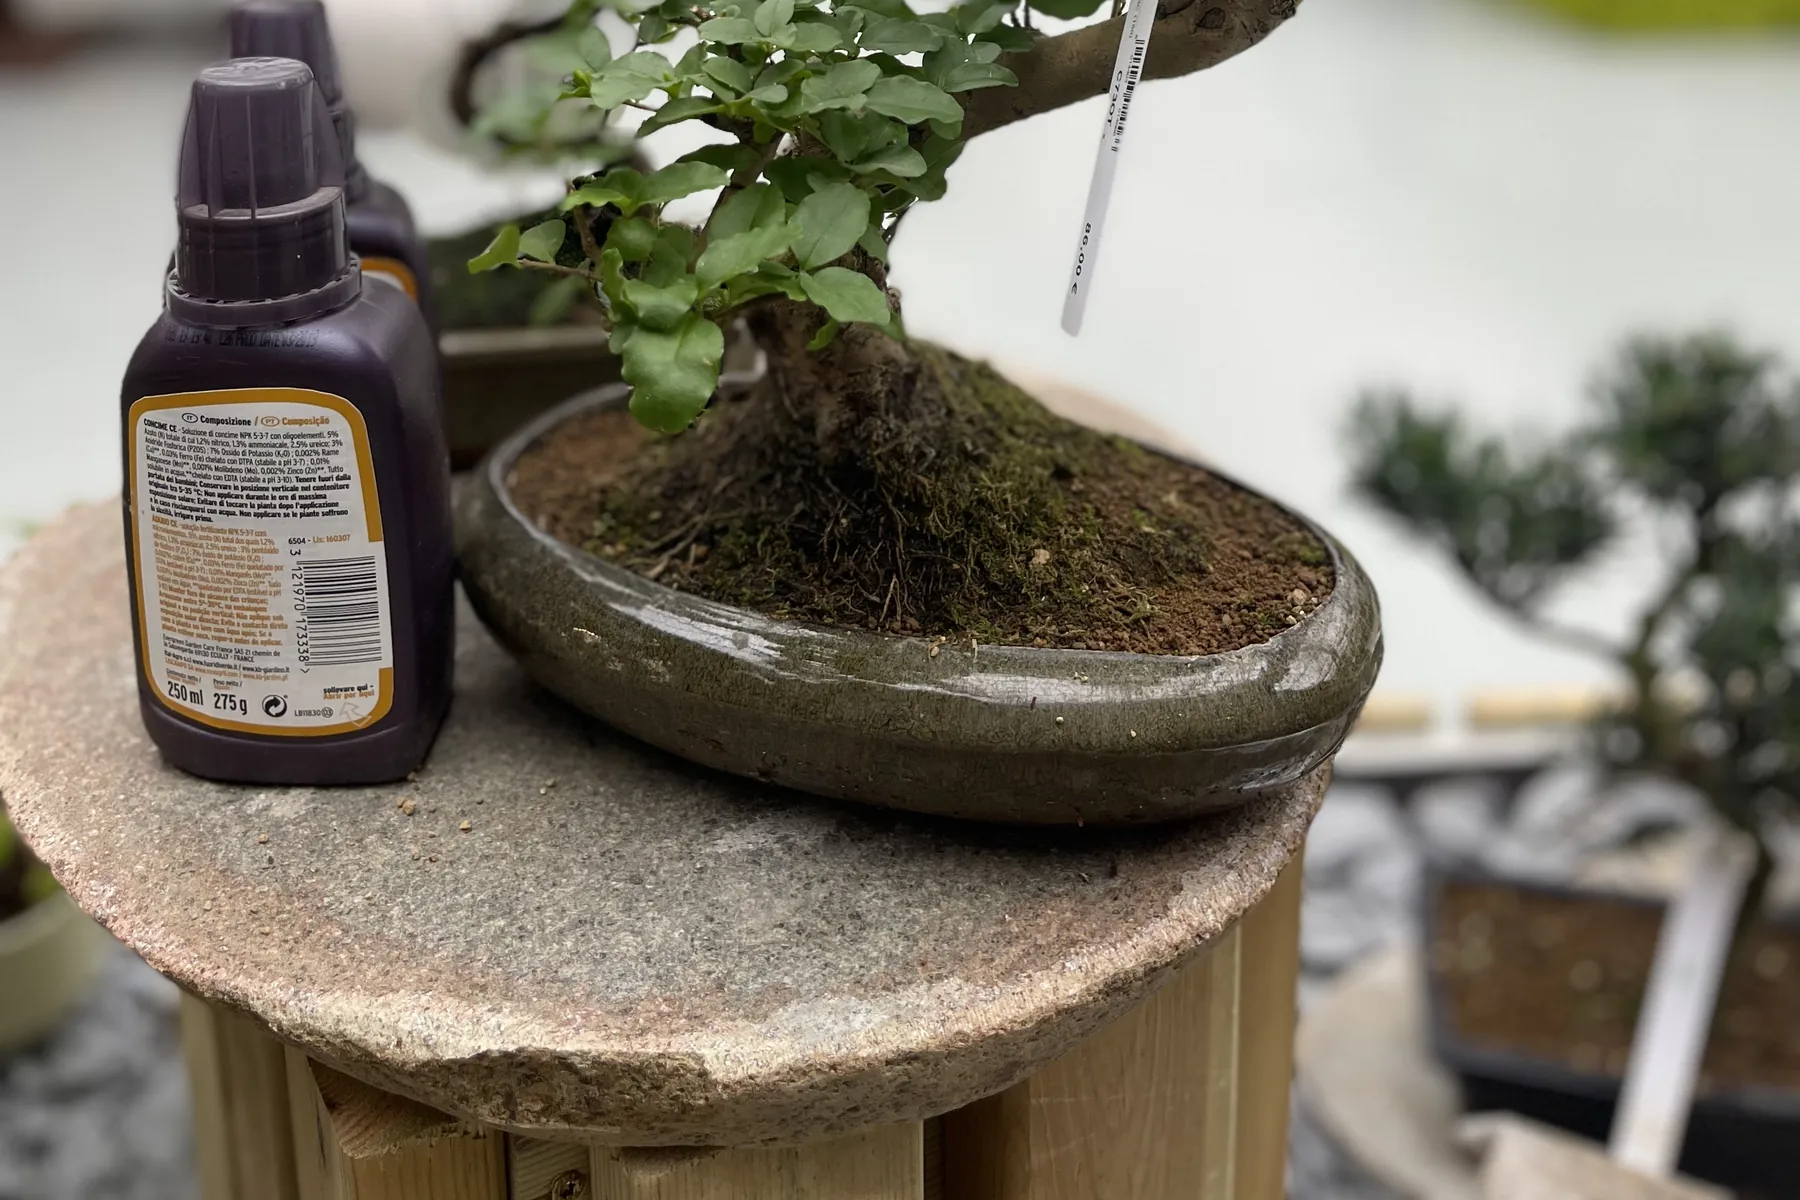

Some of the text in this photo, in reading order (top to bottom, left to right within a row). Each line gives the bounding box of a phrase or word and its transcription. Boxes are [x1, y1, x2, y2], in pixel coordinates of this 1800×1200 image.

[144, 419, 168, 430] CONCIME
[182, 427, 207, 436] Soluzione
[200, 415, 251, 426] Composizione
[282, 416, 330, 427] Composição
[210, 447, 220, 455] 7%
[221, 448, 240, 456] Ossido
[205, 455, 226, 463] chelato
[238, 458, 253, 466] DTPA
[254, 458, 276, 467] (stabile
[283, 459, 291, 468] pH
[214, 465, 243, 473] Molibdeno
[224, 474, 238, 482] EDTA
[267, 476, 276, 485] pH
[318, 474, 334, 482] fuori
[199, 480, 232, 490] Conservare
[241, 485, 270, 493] posizione
[271, 484, 300, 492] verticale
[312, 483, 350, 491] contenitore
[178, 486, 193, 495] 5-35
[217, 492, 244, 500] applicare
[245, 493, 270, 501] durante
[197, 497, 218, 506] Evitare
[225, 500, 248, 508] toccare
[257, 502, 277, 511] pianta
[278, 502, 294, 511] dopo
[295, 501, 339, 510] l'applicazione
[239, 510, 252, 518] Non
[253, 511, 282, 520] applicare
[300, 511, 320, 520] piante
[288, 537, 306, 545] 6504
[326, 534, 351, 543] 160307
[291, 567, 306, 611] 121970
[296, 617, 310, 662] 173338
[203, 643, 215, 651] Care
[233, 647, 244, 655] SAS
[252, 649, 272, 657] chemin
[234, 654, 255, 663] FRANCE
[323, 684, 368, 694] sollevare qui
[168, 680, 187, 701] 250
[189, 690, 204, 706] ml
[213, 693, 237, 711] 275
[240, 699, 248, 715] g
